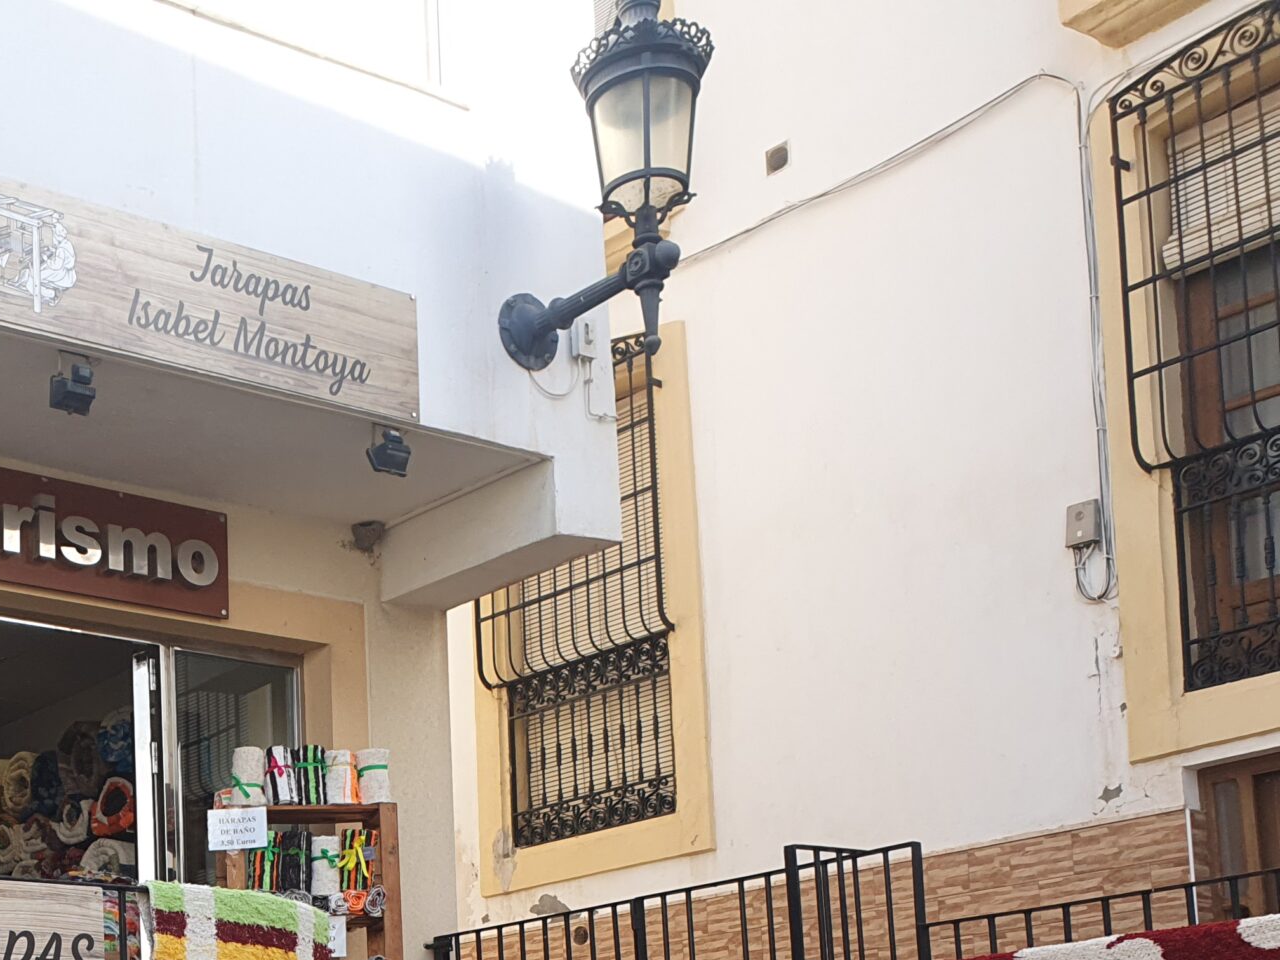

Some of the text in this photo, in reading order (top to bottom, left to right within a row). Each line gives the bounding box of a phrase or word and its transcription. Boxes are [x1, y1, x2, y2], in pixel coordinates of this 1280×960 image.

[190, 244, 312, 316] Jarapas
[127, 288, 372, 396] Isabel Montoya
